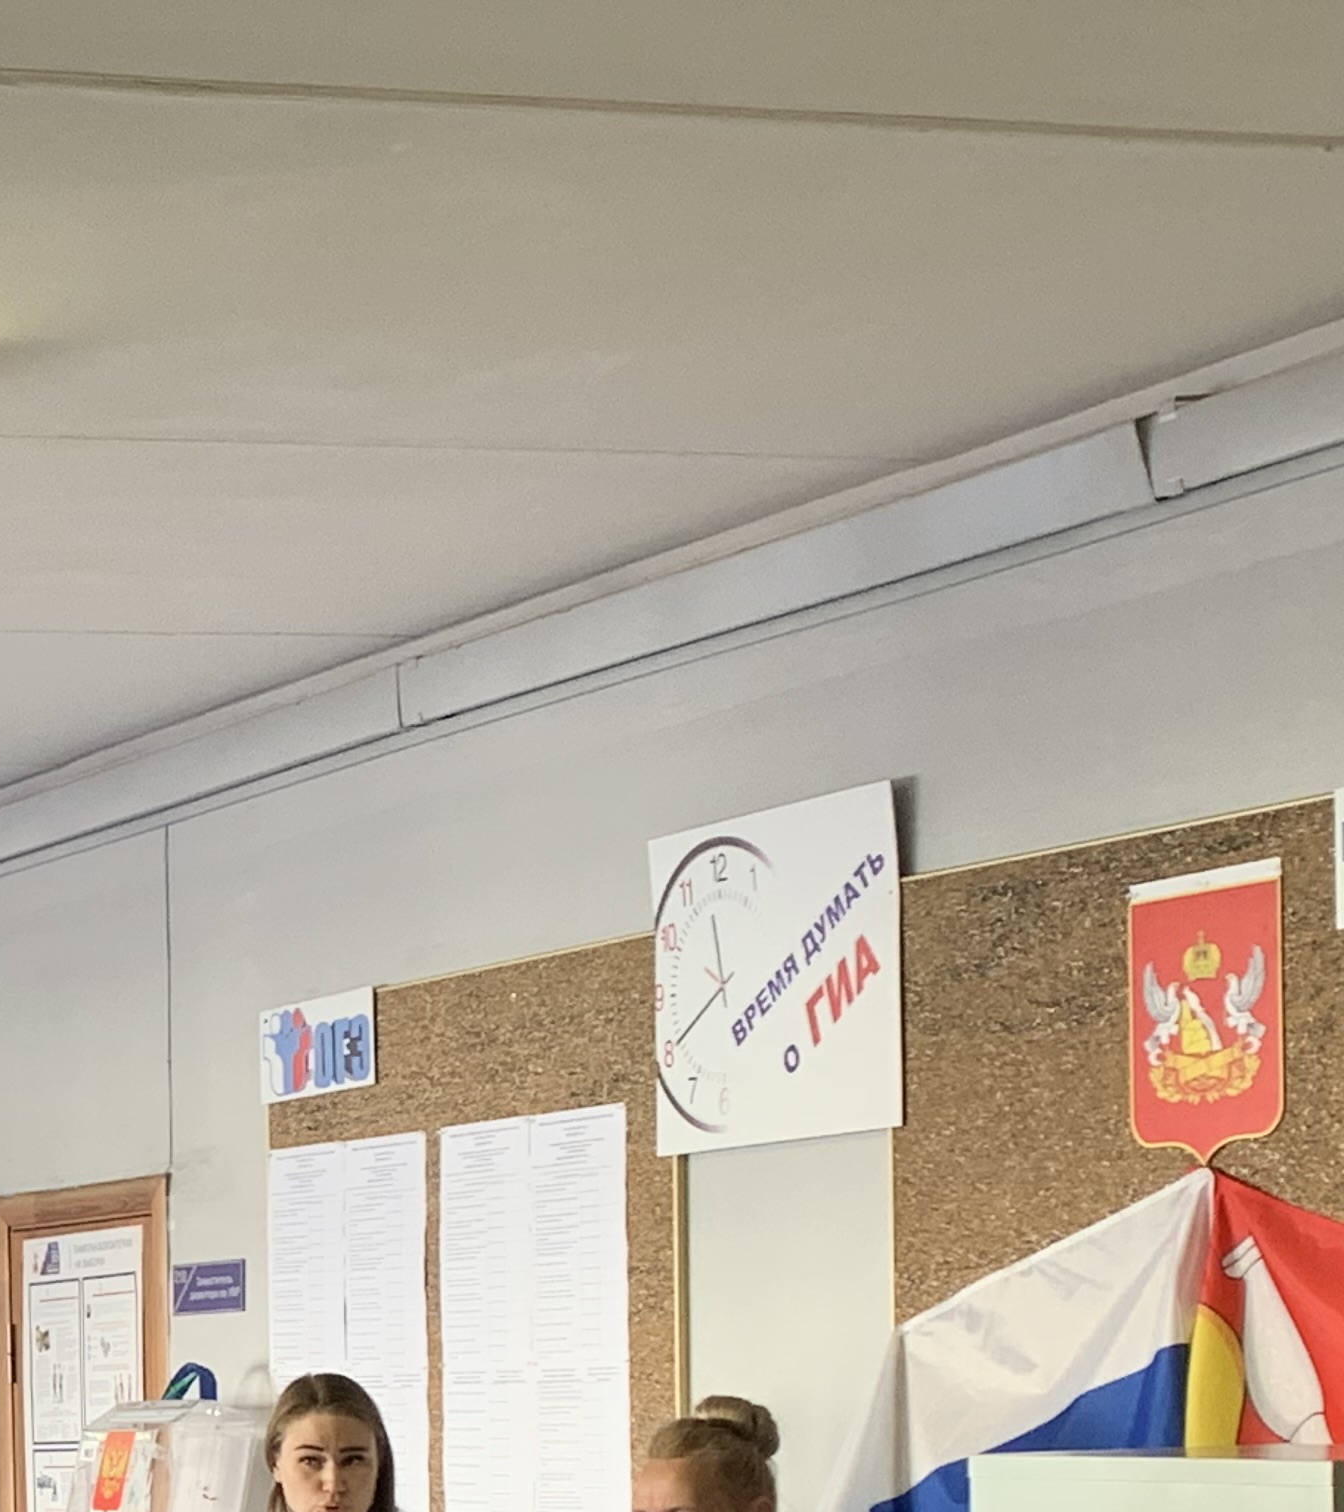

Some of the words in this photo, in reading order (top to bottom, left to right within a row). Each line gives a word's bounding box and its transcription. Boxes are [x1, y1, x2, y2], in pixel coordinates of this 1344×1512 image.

[710, 853, 728, 882] 12
[749, 864, 758, 892] 1
[679, 879, 694, 907] 11
[661, 923, 677, 951] 10
[731, 953, 800, 1046] ВРЕМЯ
[800, 854, 885, 966] ДУМАТЬ
[805, 934, 881, 1047] ГИА
[664, 1040, 674, 1068] 8
[688, 1077, 698, 1105] 7
